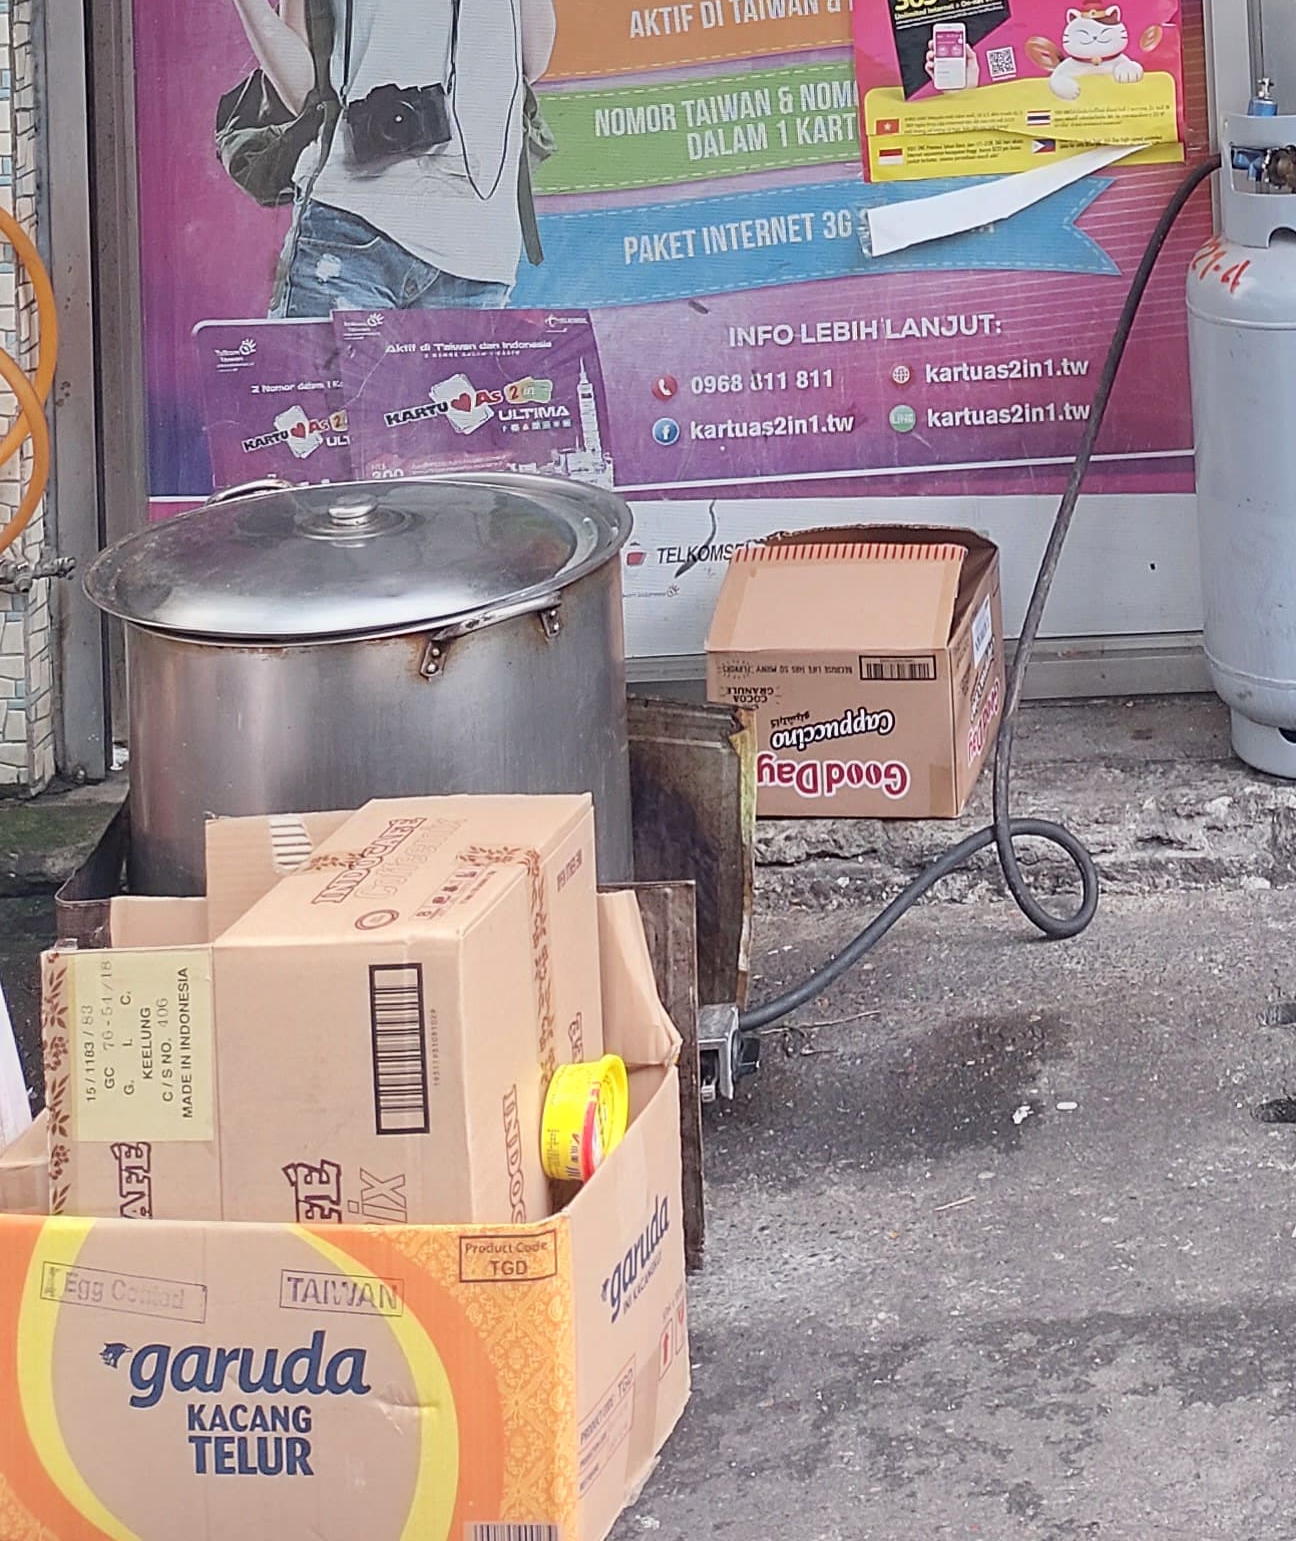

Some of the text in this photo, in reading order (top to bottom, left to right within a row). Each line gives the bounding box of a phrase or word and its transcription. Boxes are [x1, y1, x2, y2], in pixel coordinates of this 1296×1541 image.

[630, 3, 694, 38] AKTIF
[595, 80, 858, 137] NOMOR TAIWAN & NOM
[687, 112, 857, 160] DALAM 1 KART
[624, 209, 852, 265] PAKET INTERNET 3G
[385, 343, 417, 354] Aktif
[420, 341, 431, 352] di
[433, 342, 476, 351] Taiwan
[502, 339, 553, 349] Indonesia
[728, 314, 1002, 347] INFO LEBIH LANJUT:
[690, 375, 743, 395] 0968
[796, 369, 834, 389] 811
[926, 358, 1089, 384] kartuas2in1.tw
[385, 402, 448, 427] KARTU
[475, 390, 503, 407] As
[509, 385, 519, 401] 2
[499, 405, 570, 421] ULTIMA
[927, 402, 1091, 428] kartuas2in1.tw
[242, 430, 290, 452] KARTU
[308, 418, 330, 436] As
[326, 436, 351, 447] ULT
[690, 415, 855, 441] kartuas2in1.tw
[656, 542, 749, 565] TELKOMS
[726, 686, 774, 696] GRANULE
[733, 694, 768, 703] COCOA
[771, 708, 895, 752] Cappuccino
[756, 753, 911, 800] Good Day
[140, 1007, 153, 1080] KEELUNG
[161, 1037, 172, 1064] NO.
[177, 967, 193, 1118] MADE IN INDONESIA
[104, 1066, 116, 1090] GC
[503, 1084, 528, 1222] INDOC
[110, 1141, 153, 1219] AFÉ
[347, 1167, 408, 1225] ix
[463, 1239, 549, 1255] Product Code
[610, 1194, 670, 1324] garuda
[489, 1260, 529, 1277] TGD
[64, 1272, 105, 1303] Egg
[286, 1275, 398, 1312] TAIWAN
[128, 1330, 372, 1409] garuda
[187, 1403, 312, 1433] KACANG
[188, 1435, 315, 1477] TELUR
